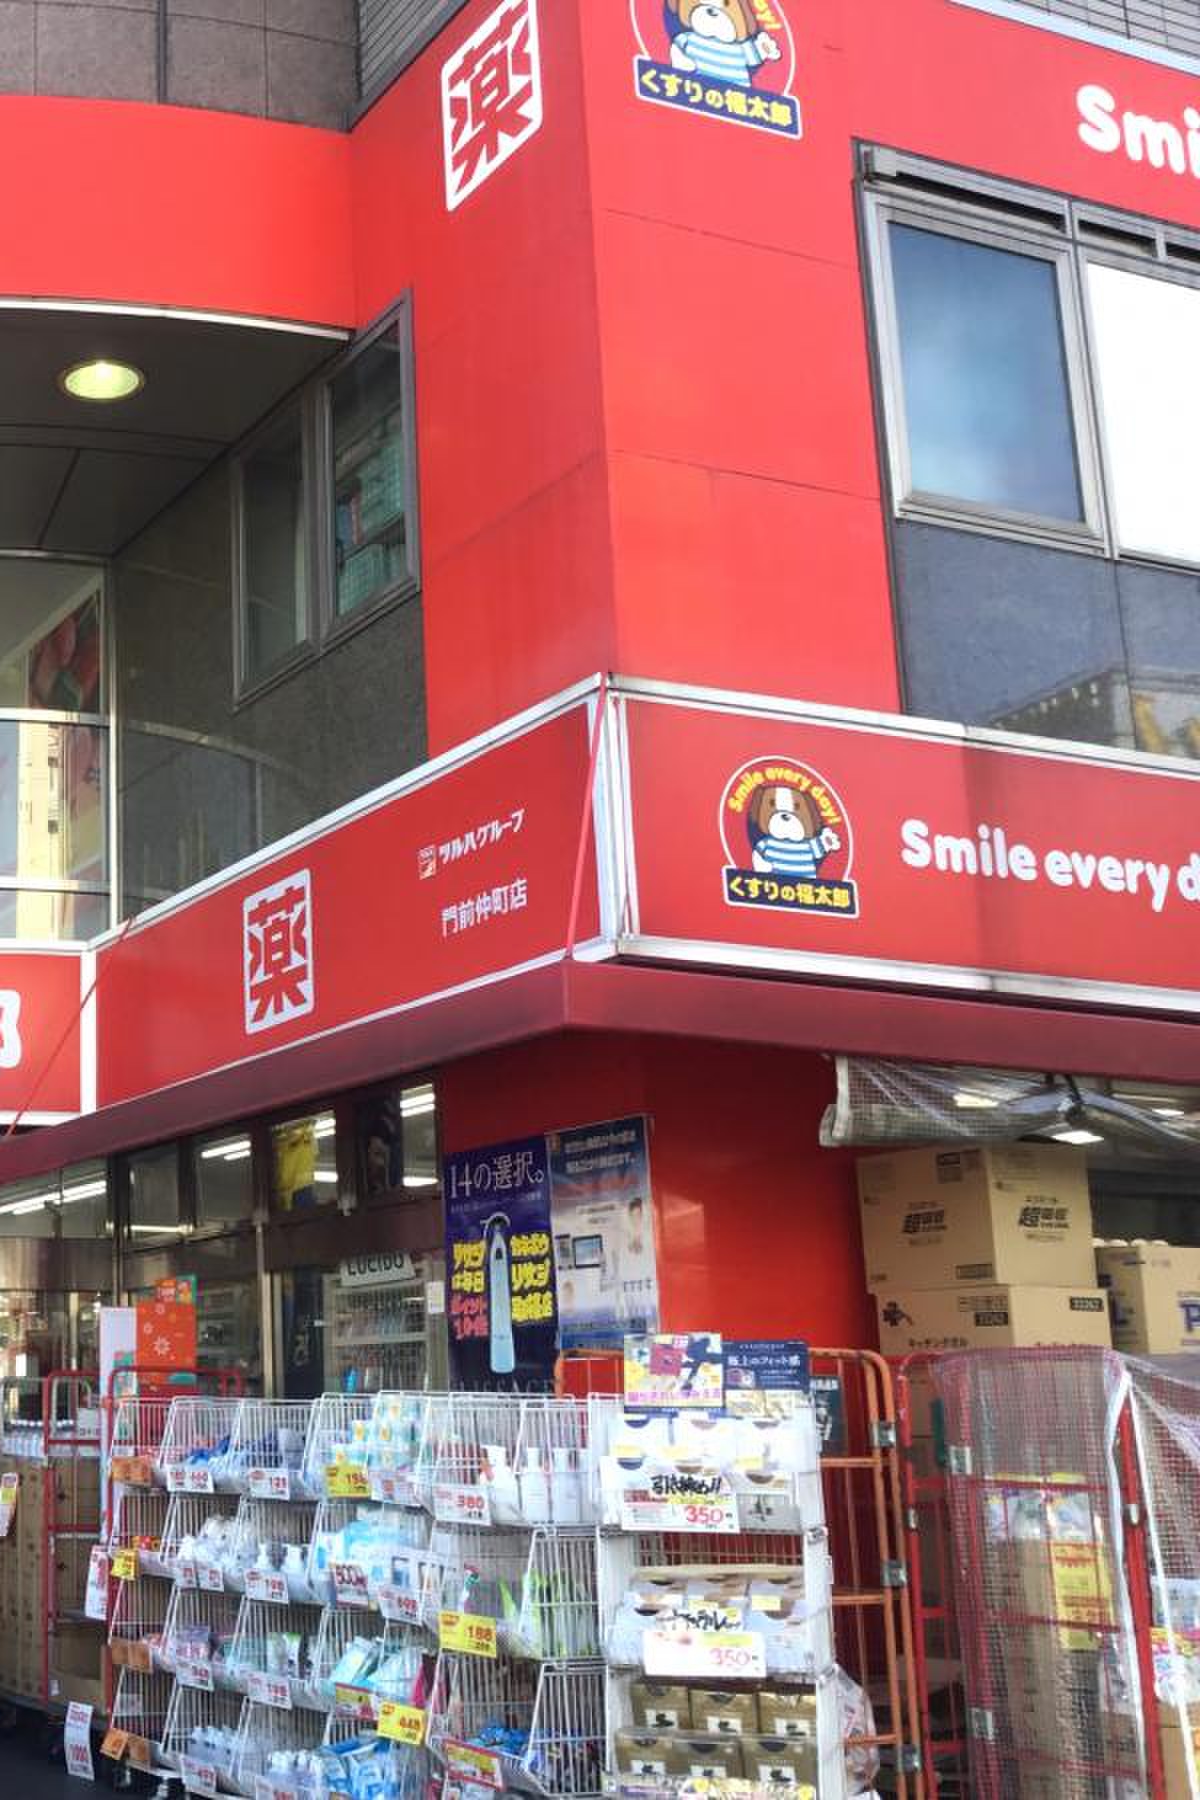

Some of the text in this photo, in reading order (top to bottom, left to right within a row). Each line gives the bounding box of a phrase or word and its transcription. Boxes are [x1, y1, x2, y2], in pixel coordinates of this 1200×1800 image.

[640, 68, 793, 128] くすりの福太郎
[1076, 84, 1200, 178] Smi
[728, 768, 842, 824] Smile every day!
[734, 876, 850, 908] くすりの福太郎
[901, 819, 1037, 881] Smile
[1044, 850, 1170, 912] every
[442, 878, 527, 937] 門前仲町店
